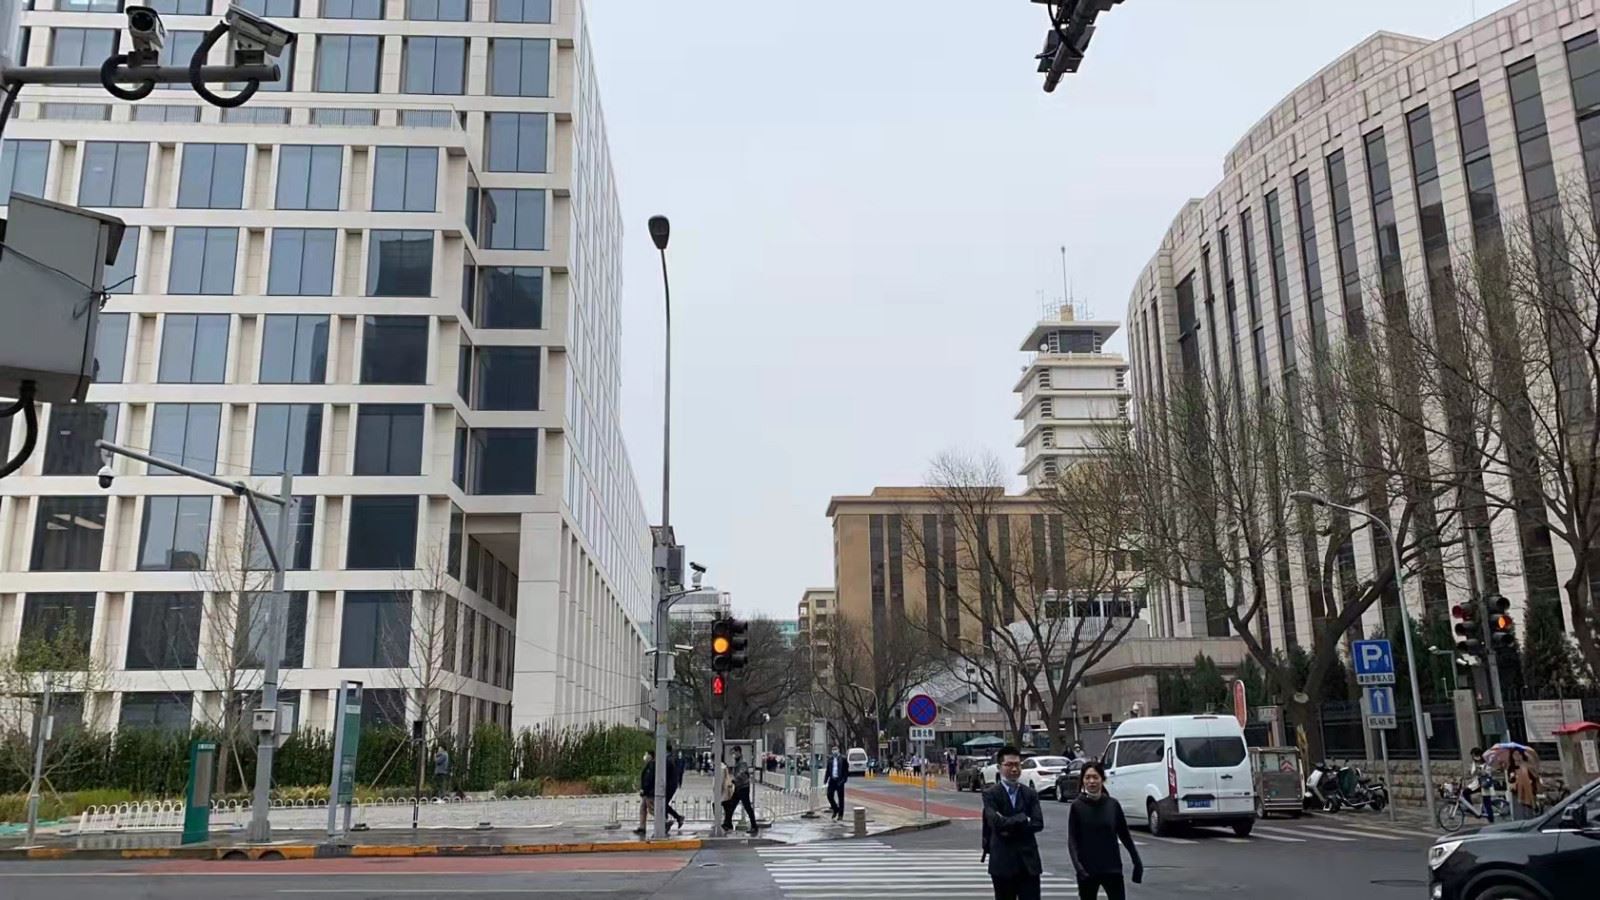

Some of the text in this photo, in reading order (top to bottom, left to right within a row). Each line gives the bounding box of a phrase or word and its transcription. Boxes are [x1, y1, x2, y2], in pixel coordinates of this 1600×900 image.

[1361, 644, 1382, 670] P
[1369, 718, 1393, 726] 机动车
